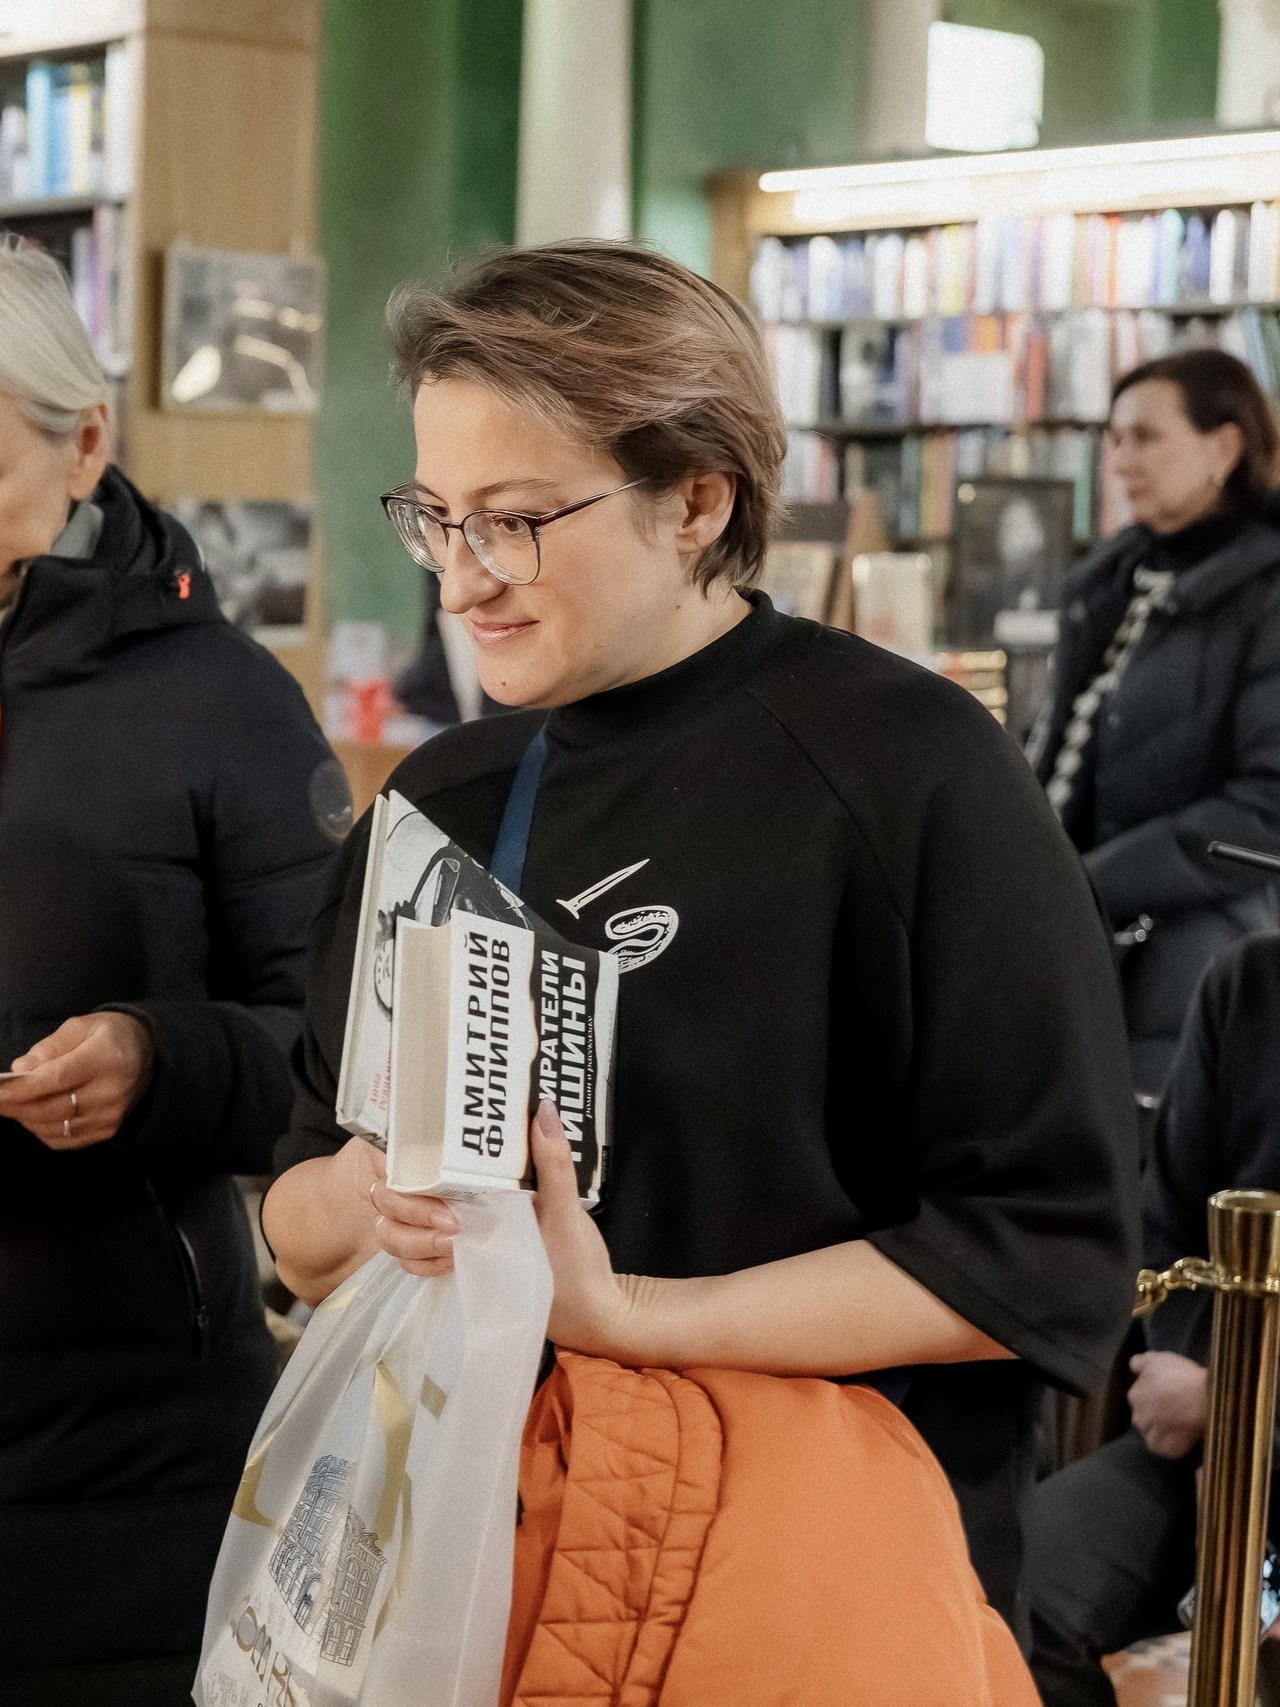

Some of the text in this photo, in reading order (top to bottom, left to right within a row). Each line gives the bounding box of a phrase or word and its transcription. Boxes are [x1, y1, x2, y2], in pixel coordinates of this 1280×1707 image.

[462, 931, 488, 1155] ДМИТРИЙ
[486, 939, 509, 1157] ФИЛИППОВ
[539, 950, 559, 1101] ИРАТЕЛИ
